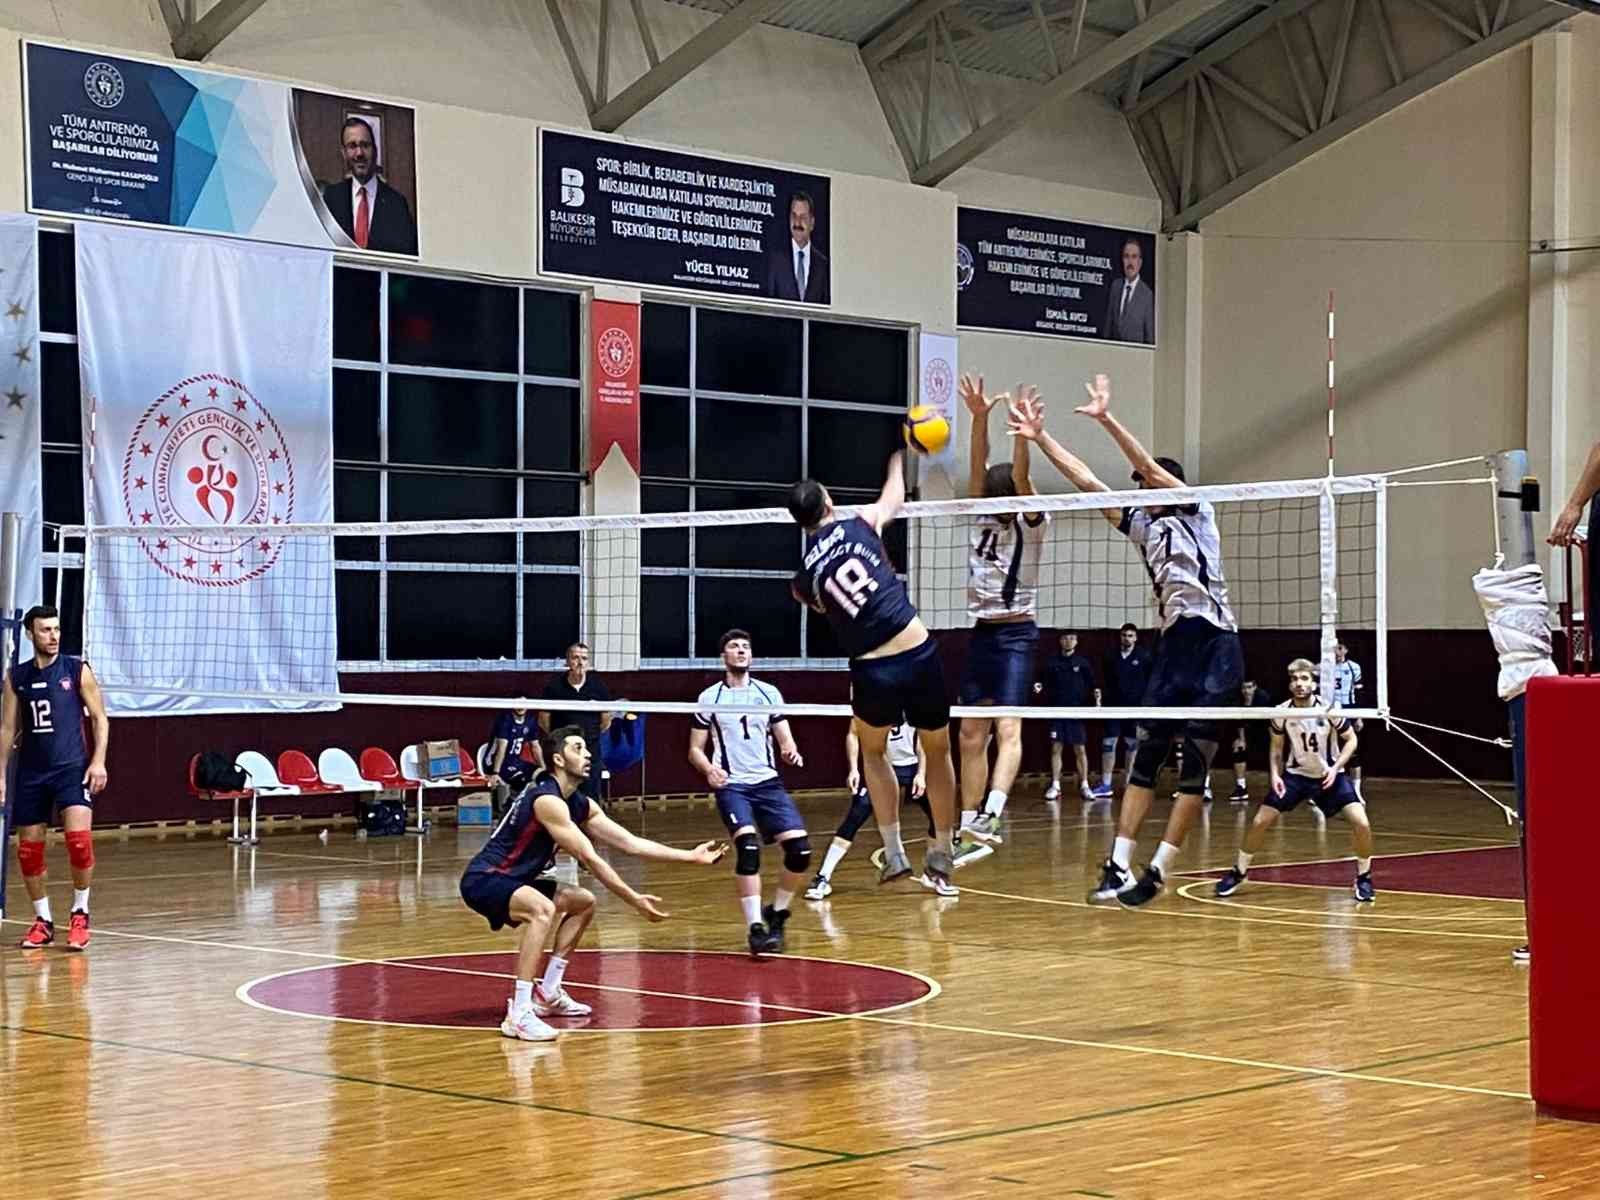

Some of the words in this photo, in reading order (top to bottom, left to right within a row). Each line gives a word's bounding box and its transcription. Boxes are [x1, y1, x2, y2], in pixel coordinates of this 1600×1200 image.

[50, 125, 64, 137] VE
[66, 128, 160, 151] SPORCULARIMIZA
[62, 114, 87, 128] TÜM
[90, 119, 147, 138] ANTRENÖR
[52, 138, 105, 156] BAŞARILAR
[106, 146, 158, 163] DİLİYORUM
[655, 166, 705, 187] BERABERLİK
[706, 174, 717, 188] VE
[599, 177, 668, 201] MÜSABAKALARA
[669, 189, 703, 206] KATILAN
[550, 209, 596, 227] BALIKESİR
[611, 200, 680, 223] HAKEMLERİMİZE
[681, 210, 693, 224] VE
[693, 211, 763, 234] GÖREVLİLERİMİZE
[611, 220, 655, 238] TEŞEKKÜR
[682, 230, 727, 247] BAŞARILAR
[685, 259, 715, 275] YÜCEL
[715, 265, 749, 279] YILMAZ
[30, 699, 52, 727] 12
[740, 715, 751, 740] 1
[509, 738, 524, 755] 15
[1301, 732, 1319, 753] 14
